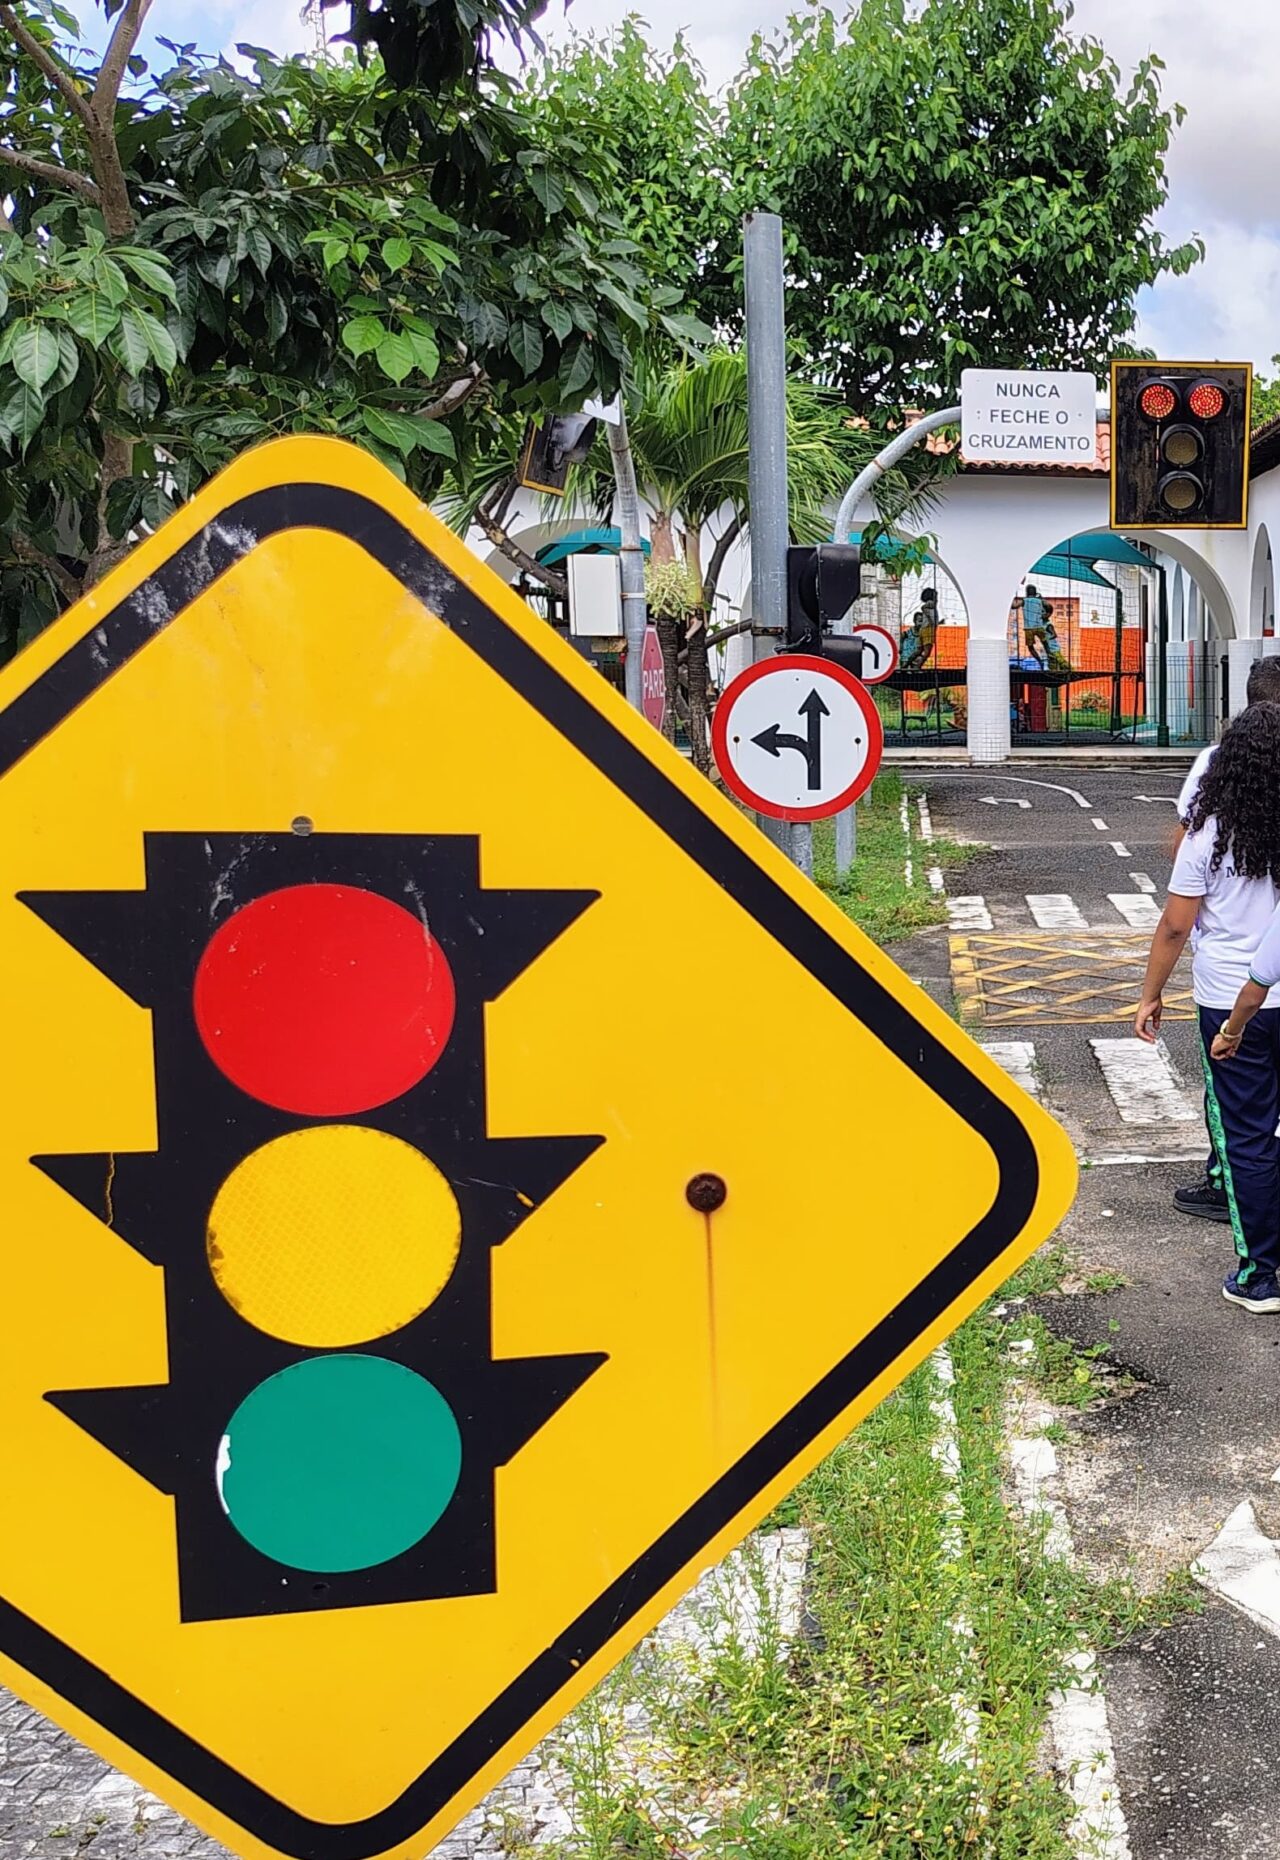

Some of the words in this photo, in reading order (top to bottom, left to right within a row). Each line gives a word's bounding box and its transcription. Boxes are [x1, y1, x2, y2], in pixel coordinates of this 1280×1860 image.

[996, 383, 1060, 398] NUNCA
[990, 409, 1050, 424] FECHE
[1056, 411, 1068, 424] O
[968, 434, 1090, 450] CRUZAMENTO
[643, 669, 665, 699] PARE
